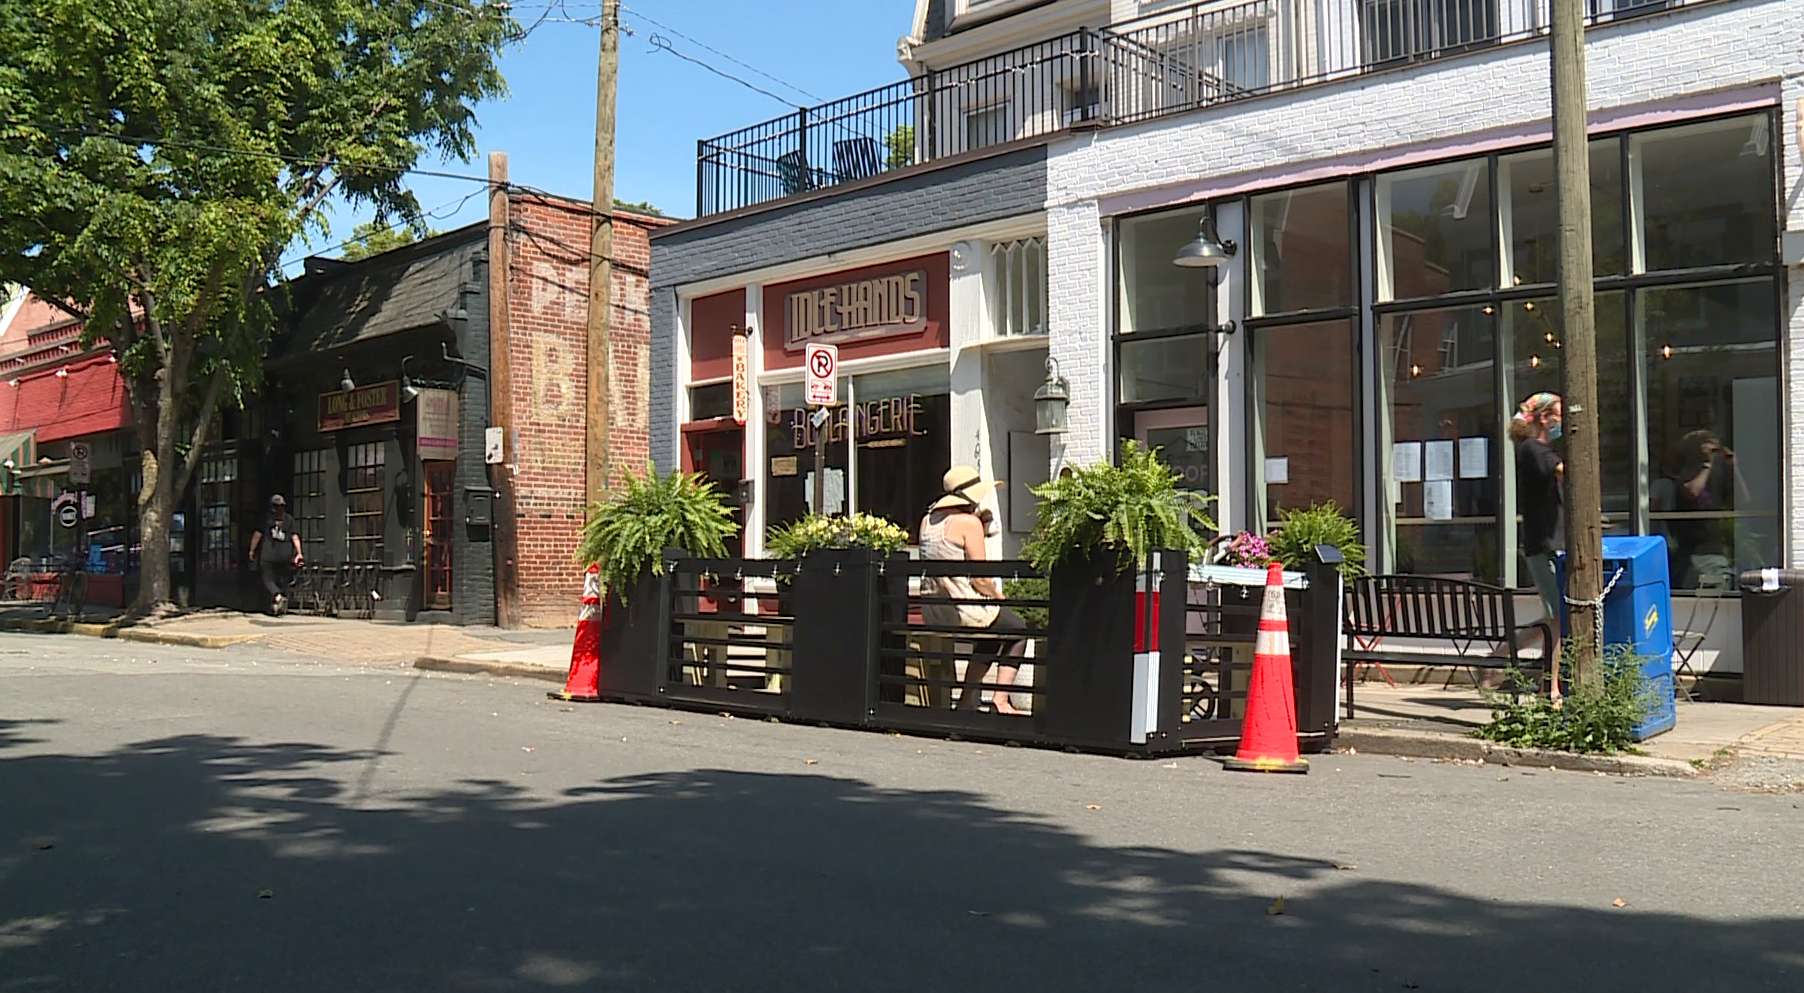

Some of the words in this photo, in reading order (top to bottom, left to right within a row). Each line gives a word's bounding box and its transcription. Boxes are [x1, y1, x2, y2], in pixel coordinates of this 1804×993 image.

[791, 286, 838, 342] IDLE
[836, 271, 921, 330] HANDS
[327, 393, 348, 415] LONG
[348, 392, 355, 411] &
[356, 387, 387, 409] FOSTER
[735, 362, 747, 418] BAKERY
